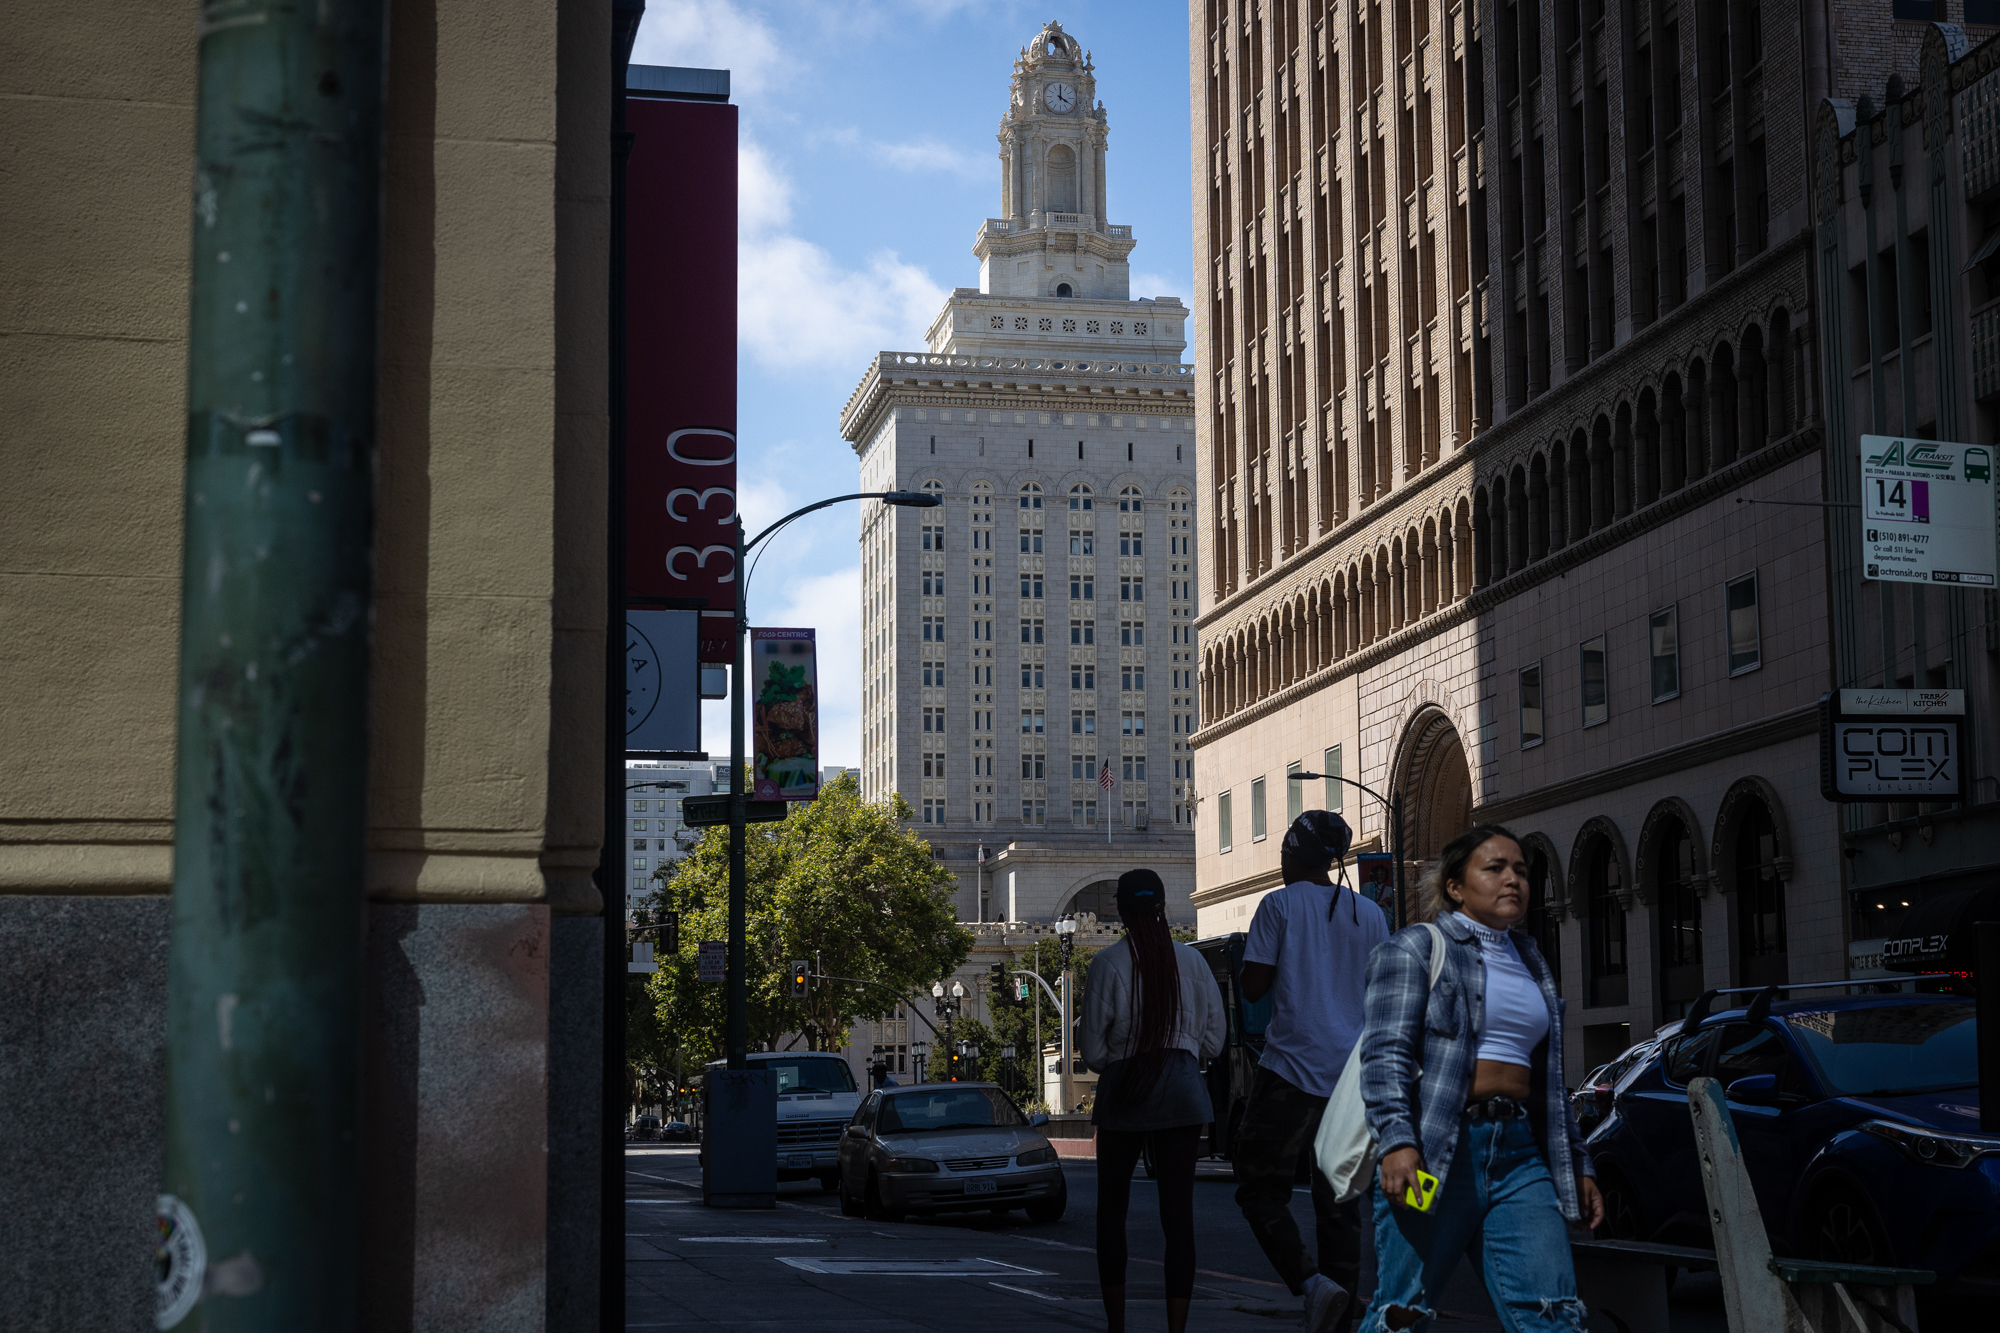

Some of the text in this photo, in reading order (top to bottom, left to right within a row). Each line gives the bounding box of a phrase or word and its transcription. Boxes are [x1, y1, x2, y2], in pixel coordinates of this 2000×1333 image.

[1919, 452, 1955, 461] TRANSIT
[1876, 479, 1906, 508] 14
[1879, 532, 1929, 544] (510) 891-4777
[1874, 553, 1901, 562] departure
[1880, 568, 1928, 580] actransit.org
[1934, 572, 1950, 580] STOP
[1843, 728, 1950, 756] COM
[1848, 758, 1951, 781] PLEX
[1867, 783, 1933, 791] OAKLAND
[1883, 934, 1949, 957] COMPLEX
